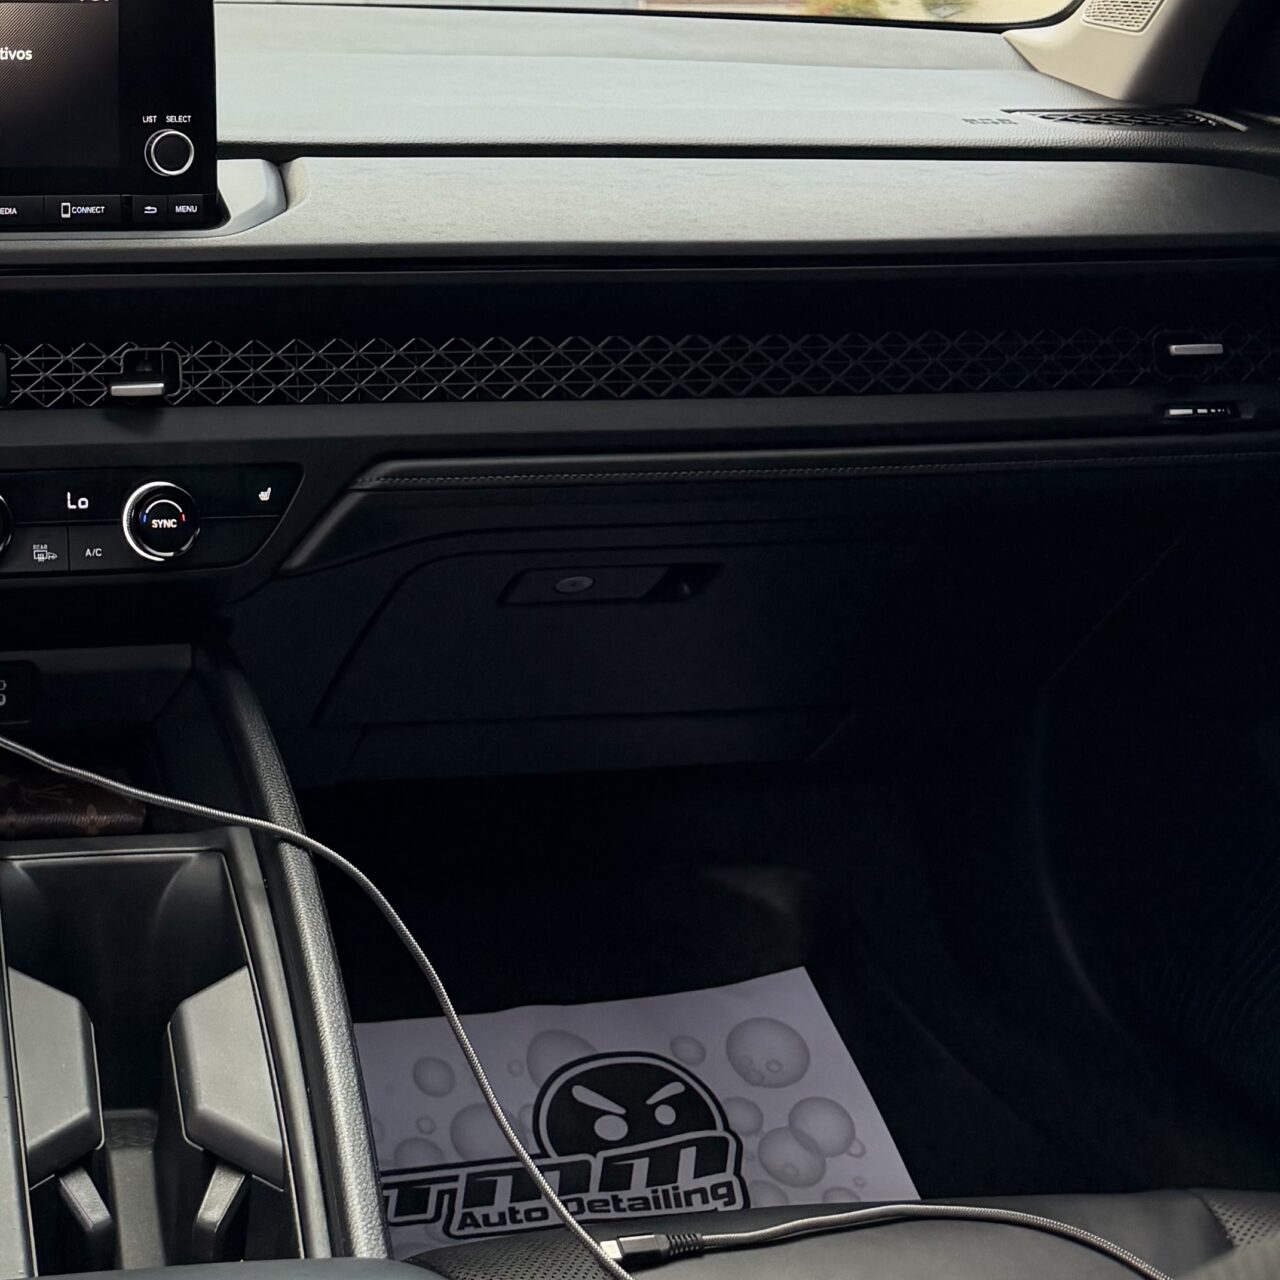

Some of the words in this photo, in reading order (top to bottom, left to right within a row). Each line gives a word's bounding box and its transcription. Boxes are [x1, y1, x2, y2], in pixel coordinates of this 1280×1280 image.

[142, 115, 158, 124] LIST
[165, 115, 192, 124] SELECT
[71, 205, 105, 215] CONNECT
[175, 205, 198, 214] MENU
[67, 491, 89, 509] Lo
[152, 519, 177, 529] SYNC
[32, 544, 48, 552] REAR
[85, 548, 102, 558] A/C
[456, 1204, 549, 1232] Auto
[568, 1180, 736, 1216] Detailing
